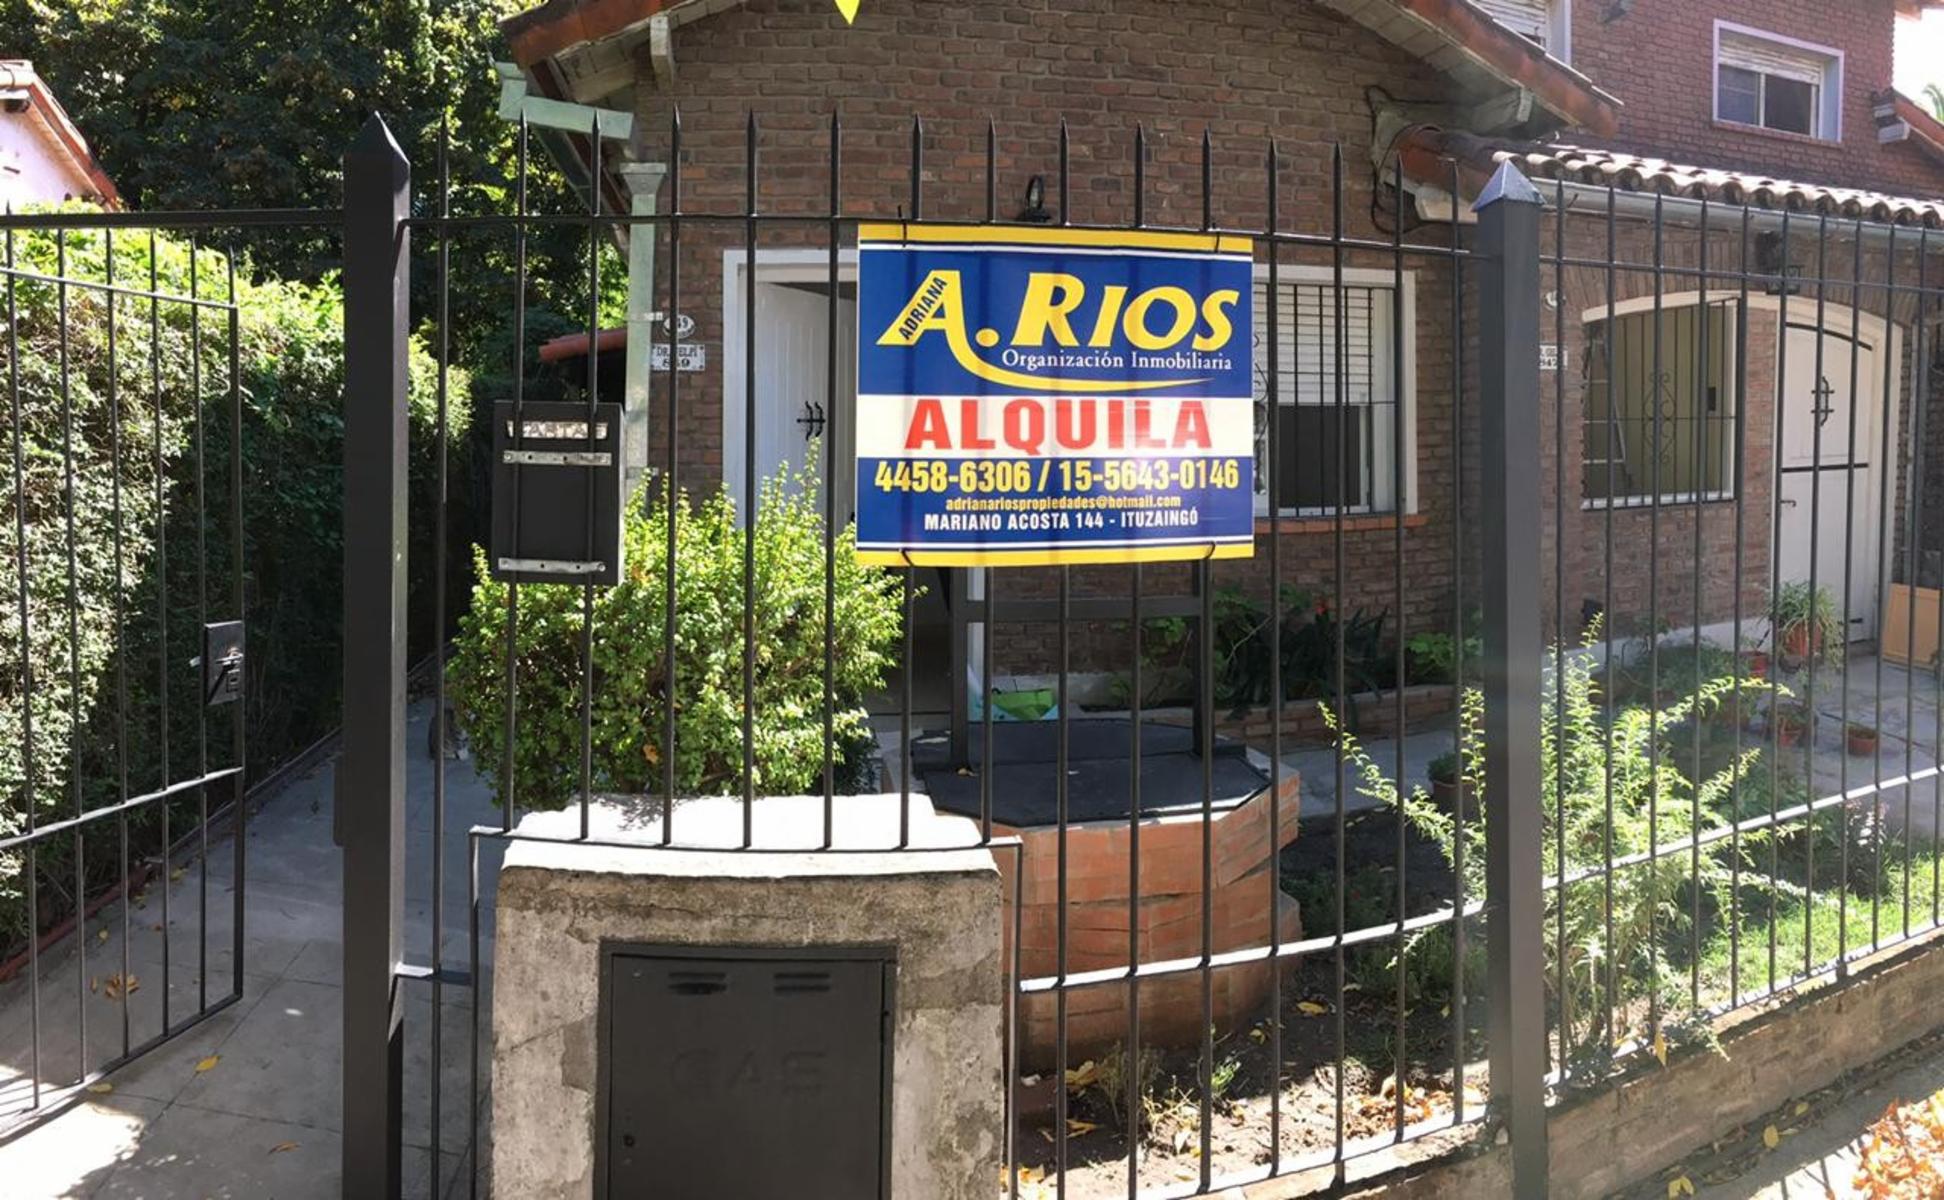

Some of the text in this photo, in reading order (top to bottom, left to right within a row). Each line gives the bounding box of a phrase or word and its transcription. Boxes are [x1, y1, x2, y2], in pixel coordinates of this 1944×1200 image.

[898, 276, 948, 341] ADRIANA
[1010, 271, 1240, 352] RIOS
[1001, 348, 1233, 370] Organización Inmobiliaria
[904, 398, 1213, 456] ALQUILA
[874, 460, 1032, 493] 4458-6306
[1058, 458, 1240, 492] 15-5643-0146
[924, 513, 1002, 531] MARIANO
[1007, 511, 1070, 530] ACOSTA
[1075, 511, 1104, 529] 144
[1120, 506, 1199, 528] ITUZAINGÓ
[945, 495, 1182, 512] adrianariospropiedades@hotmail.com
